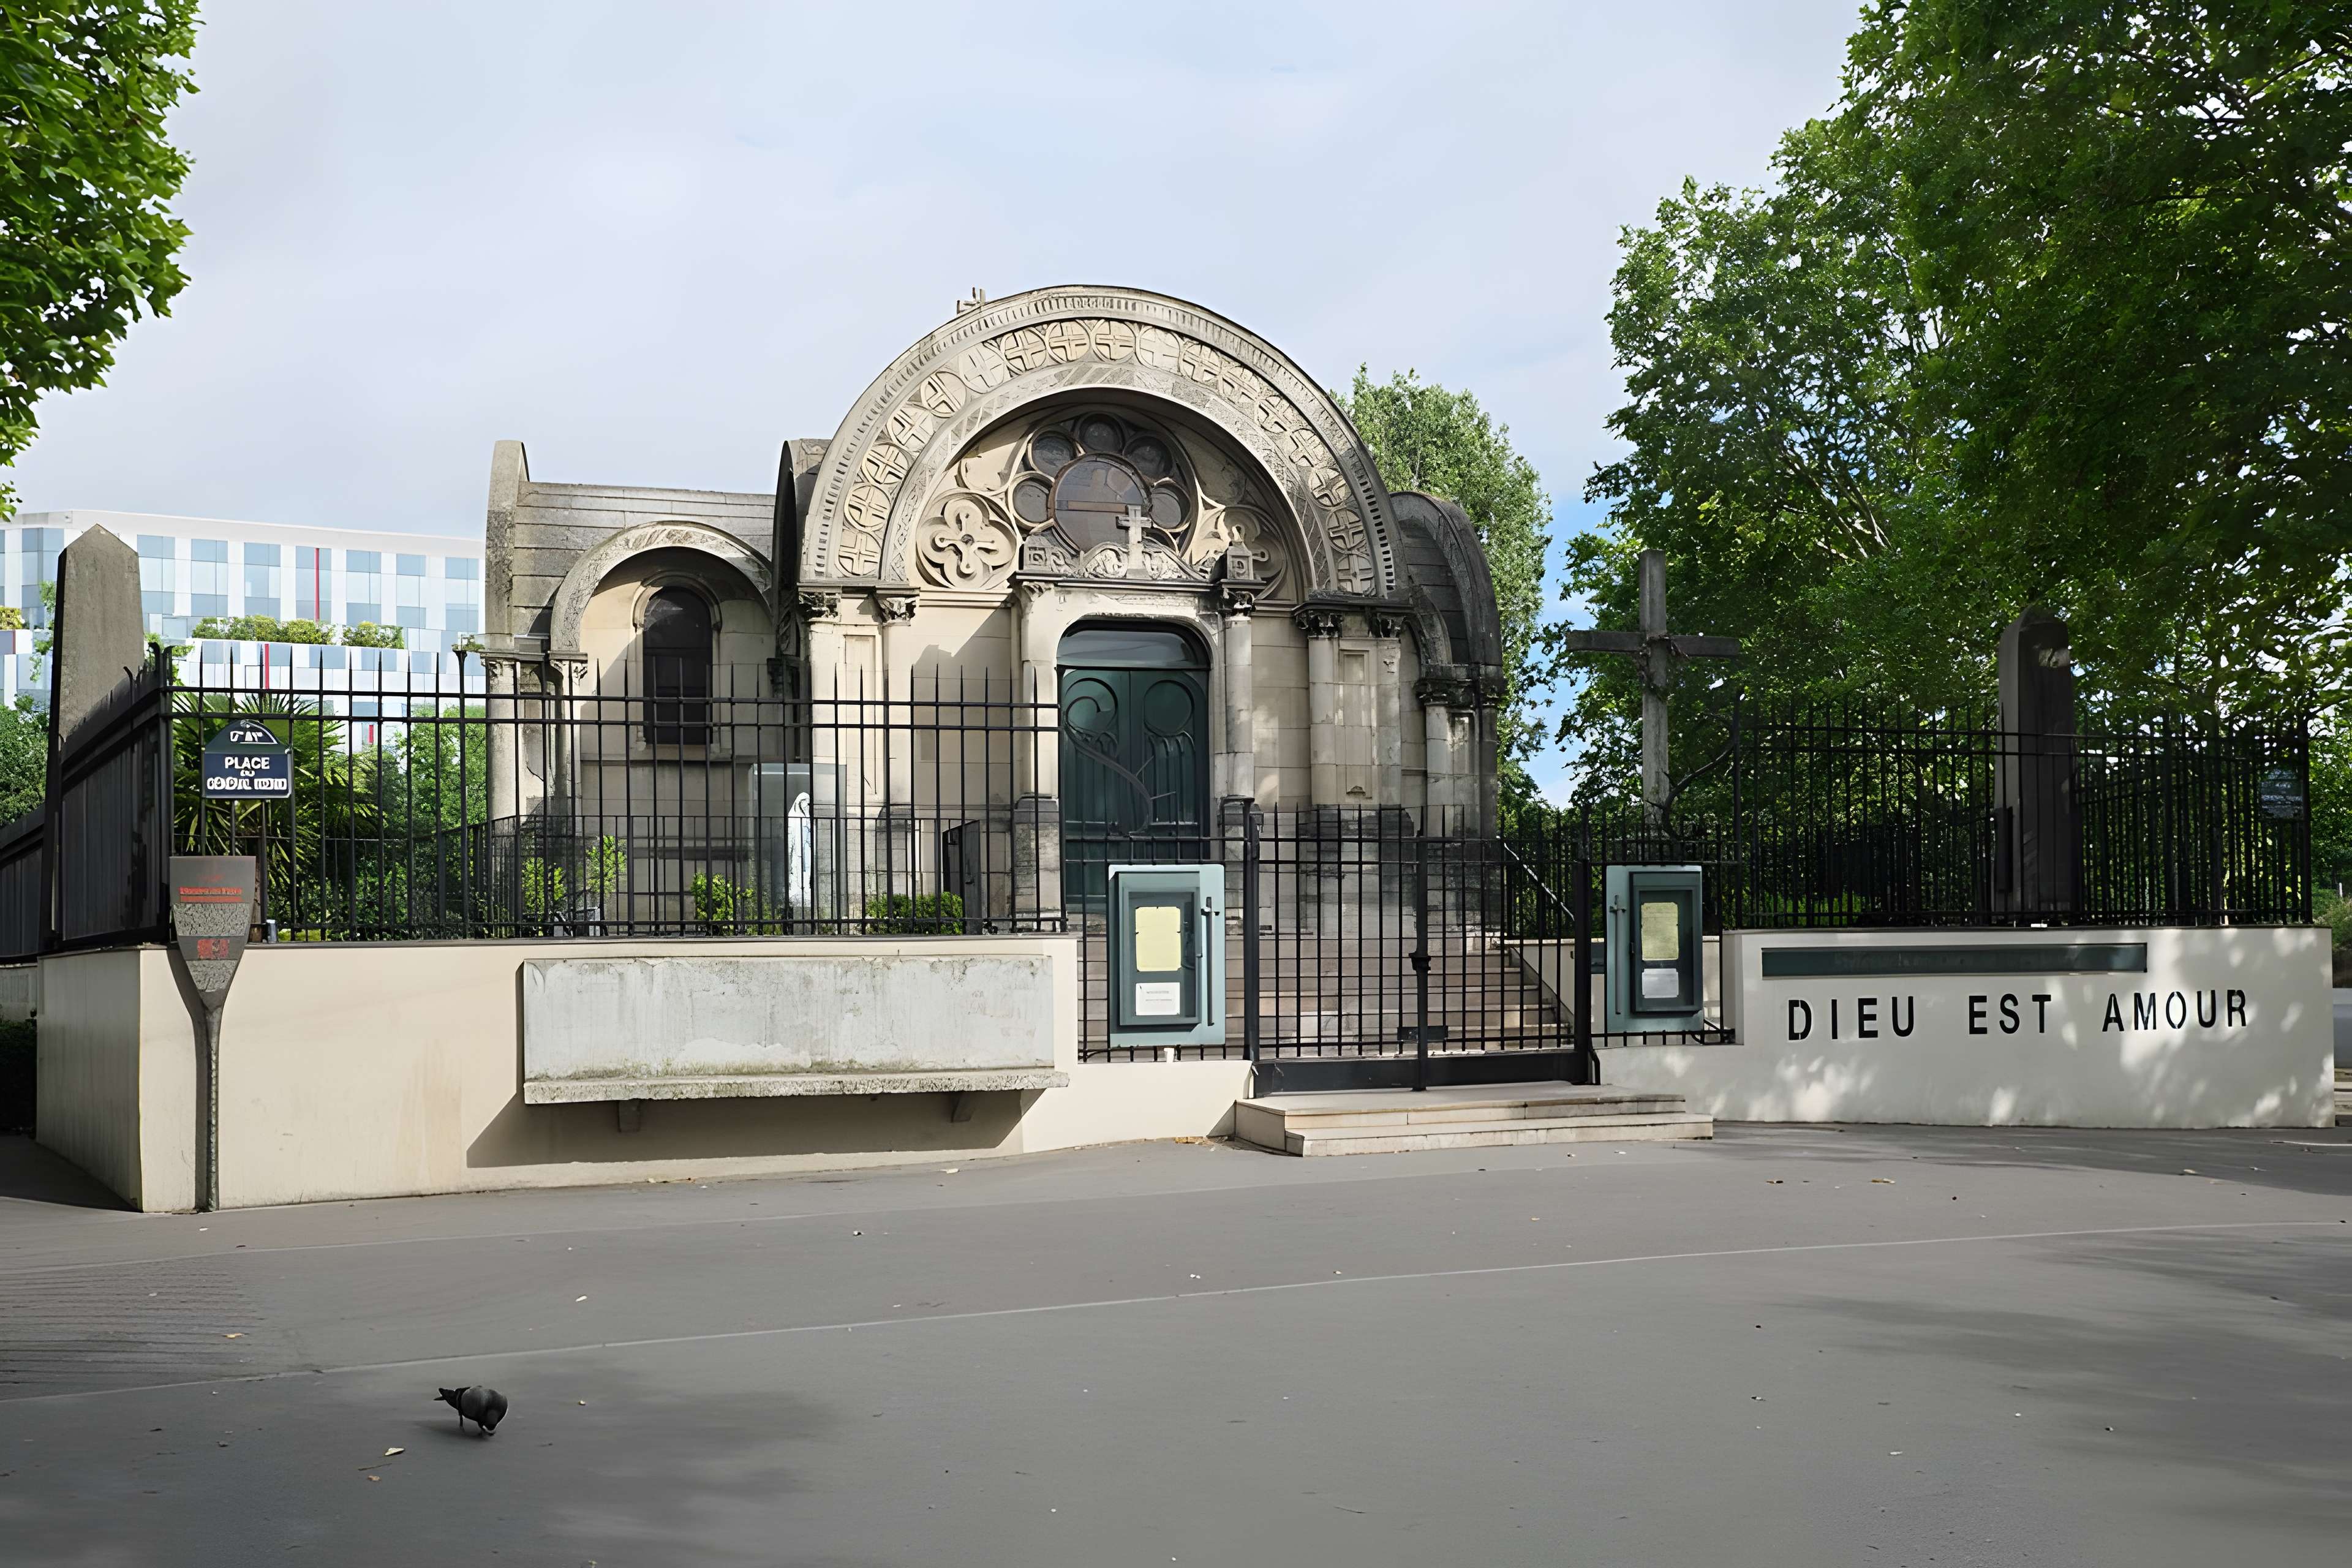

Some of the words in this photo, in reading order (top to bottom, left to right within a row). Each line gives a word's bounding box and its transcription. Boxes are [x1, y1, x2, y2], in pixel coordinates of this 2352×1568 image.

[224, 756, 270, 769] PLACE
[1788, 996, 1915, 1041] DIEU
[1968, 993, 2052, 1035] EST
[2101, 989, 2247, 1032] AMOUR
